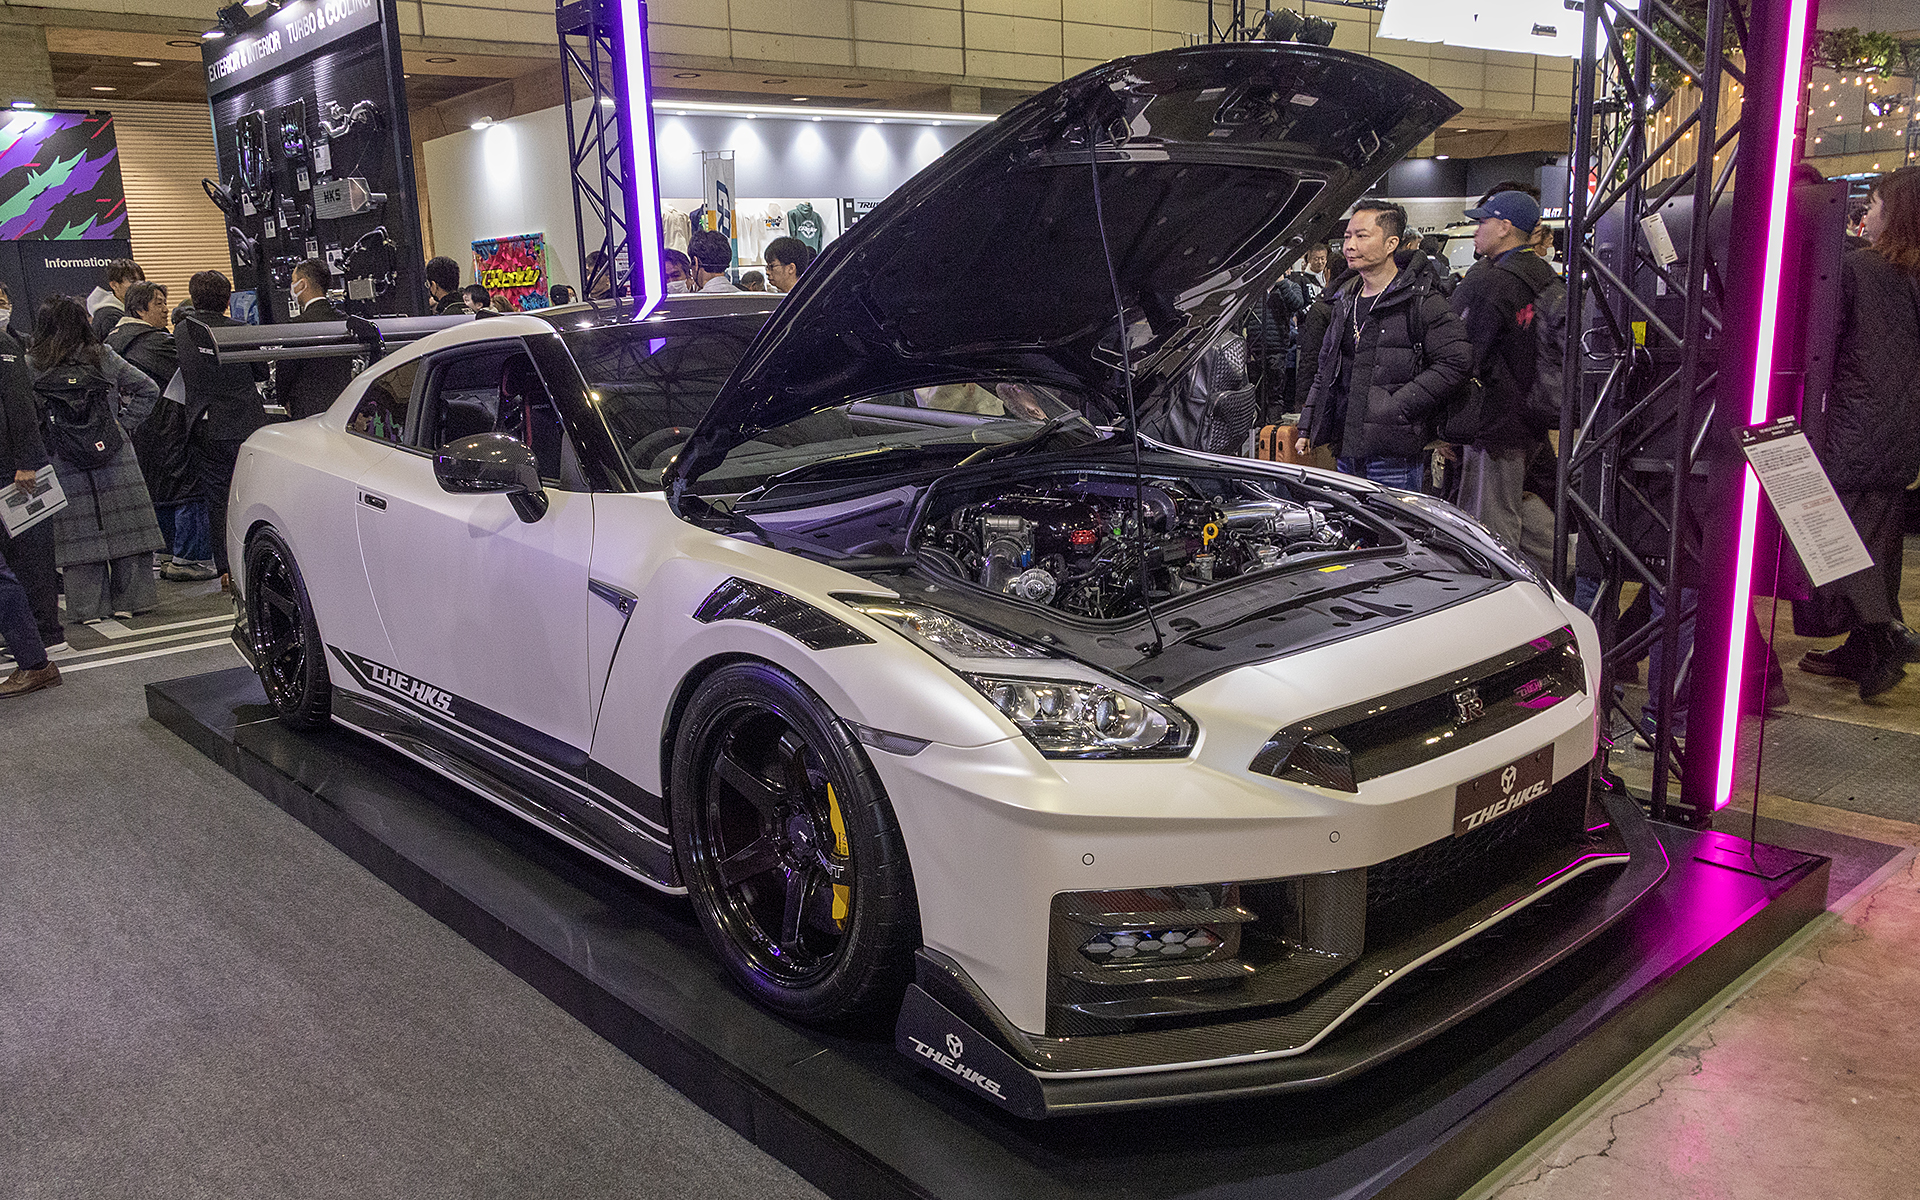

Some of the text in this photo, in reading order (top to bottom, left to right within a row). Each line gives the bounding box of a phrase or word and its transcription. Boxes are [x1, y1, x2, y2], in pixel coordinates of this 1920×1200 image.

[285, 12, 317, 44] TURBO
[316, 8, 326, 30] &
[208, 50, 241, 82] EXTERIOR
[247, 30, 282, 64] INTERIOR
[323, 188, 341, 203] HKS
[362, 660, 456, 717] THE HKS
[1461, 780, 1549, 831] THE HKS
[908, 1036, 1007, 1101] THE HKS
